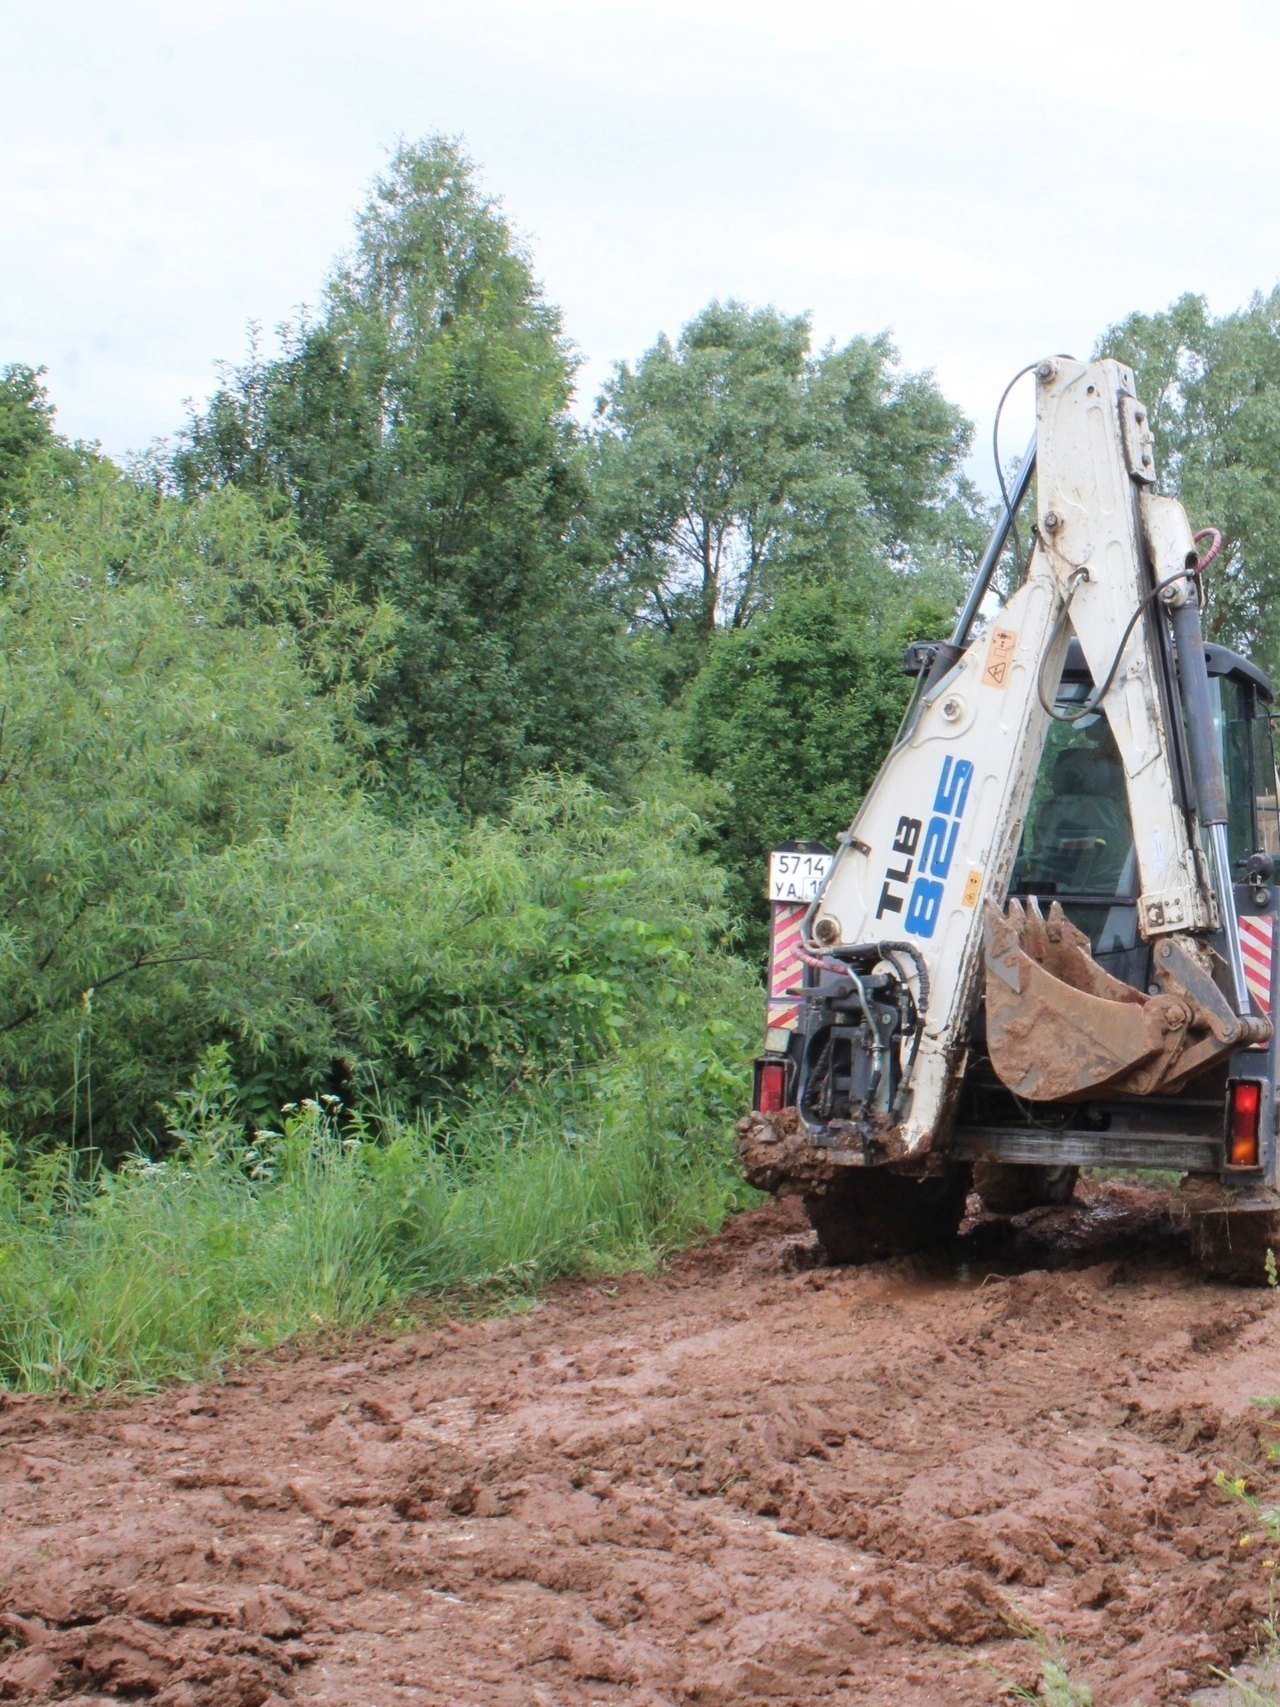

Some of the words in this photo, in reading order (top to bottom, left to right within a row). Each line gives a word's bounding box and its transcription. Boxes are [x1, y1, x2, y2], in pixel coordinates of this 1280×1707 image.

[778, 855, 824, 876] 5714
[875, 815, 922, 920] TLB
[904, 754, 975, 939] 825
